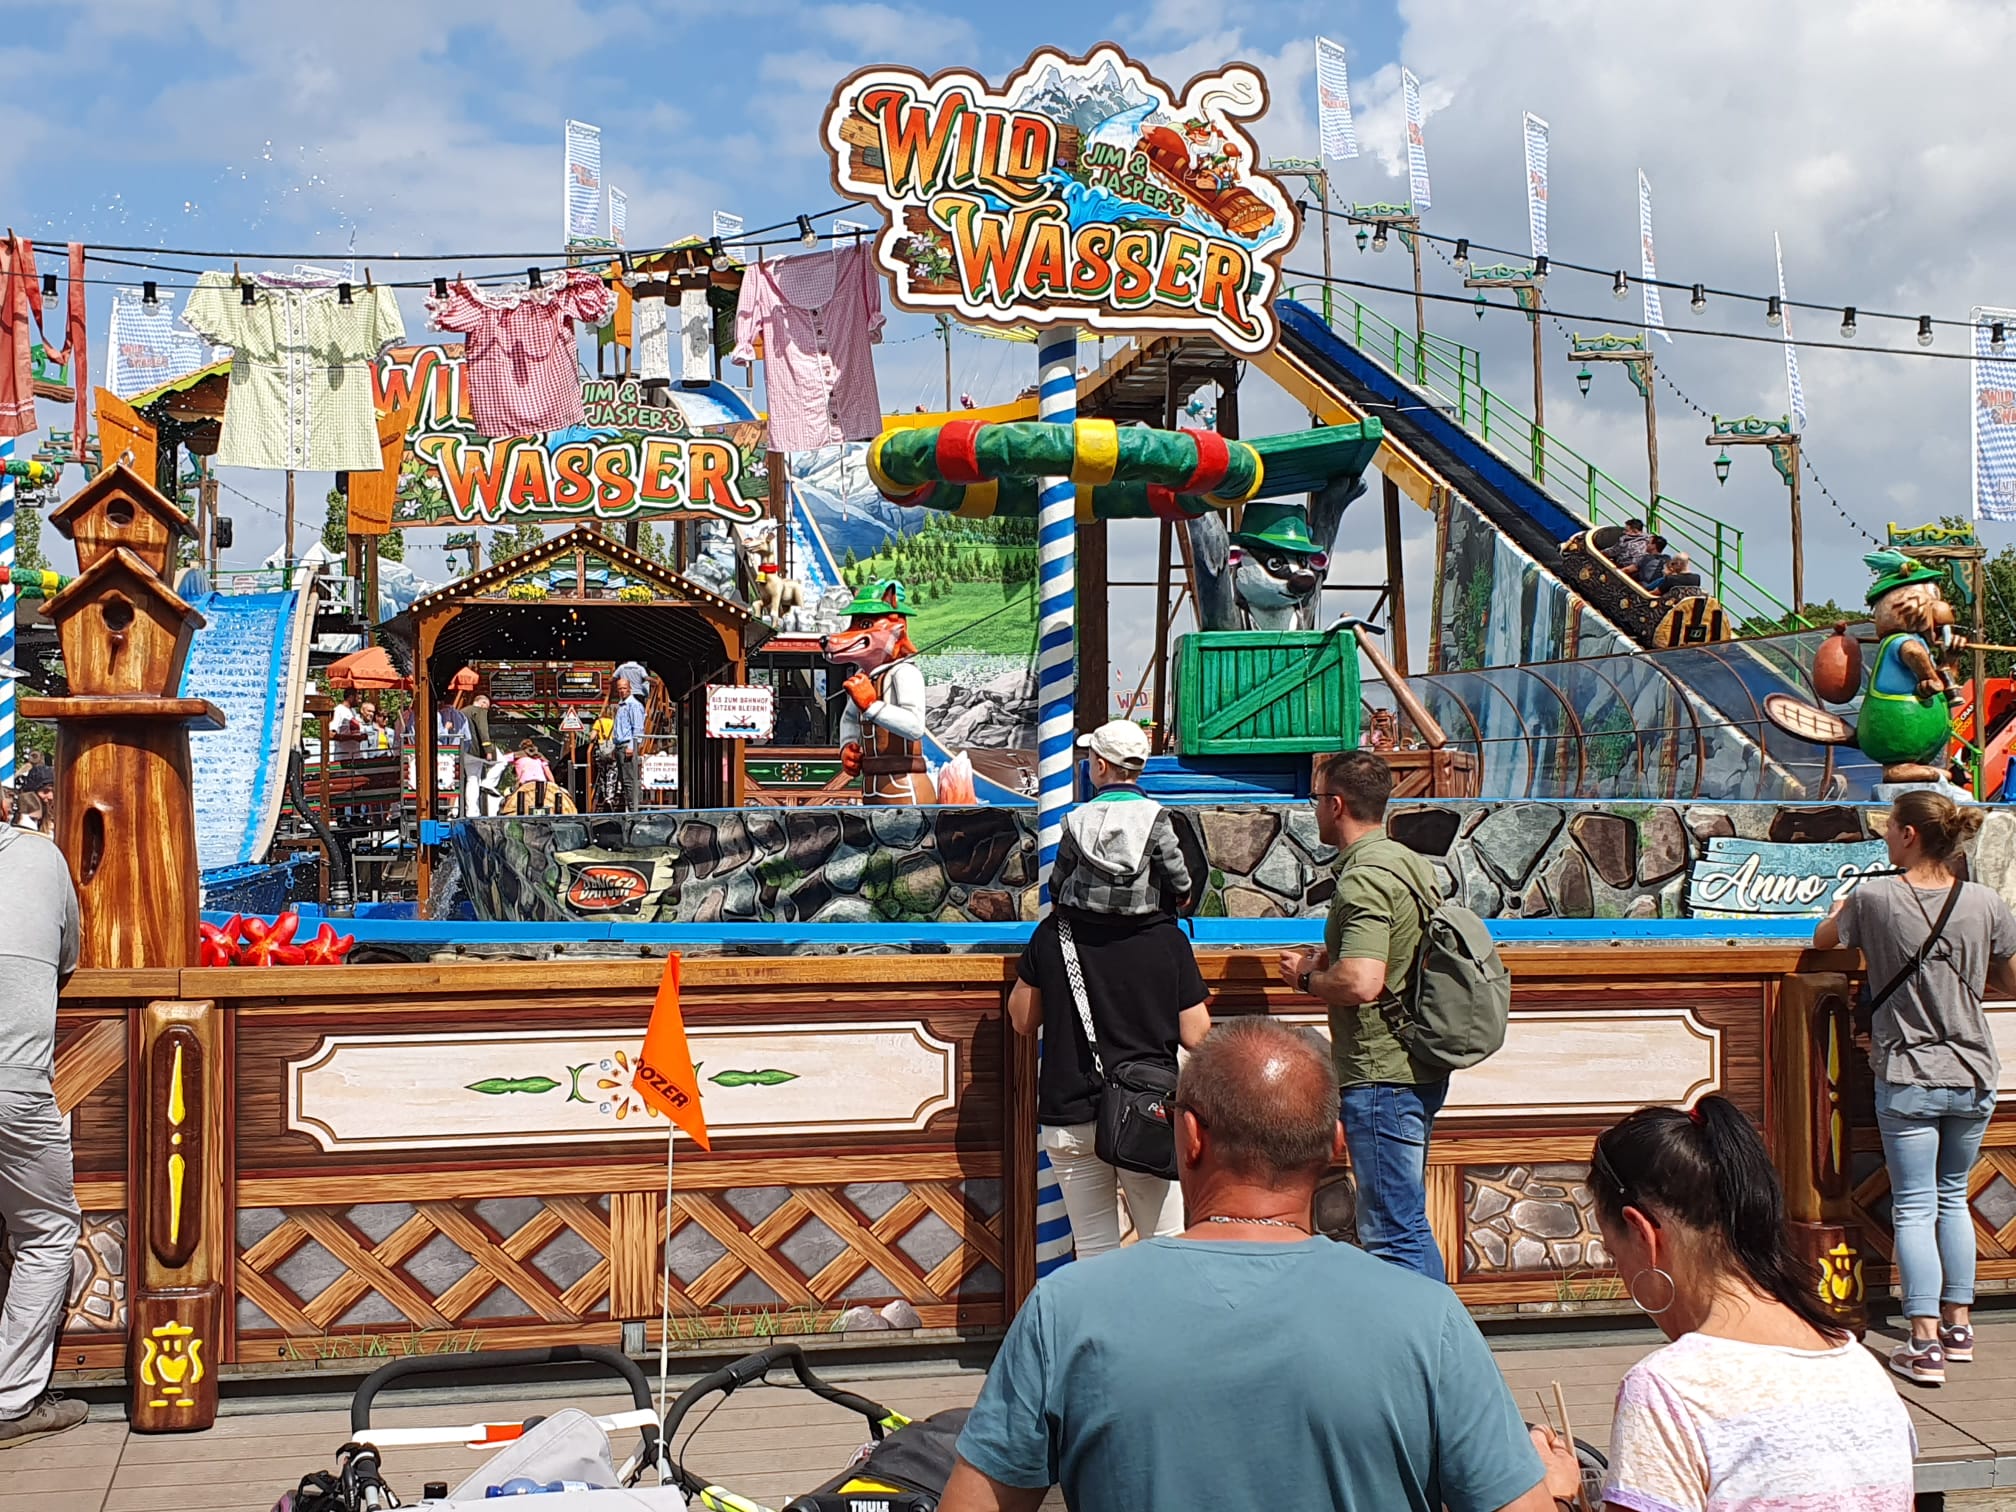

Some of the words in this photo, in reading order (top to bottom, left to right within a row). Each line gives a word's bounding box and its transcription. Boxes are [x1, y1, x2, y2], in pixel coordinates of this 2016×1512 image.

[860, 88, 1055, 201] WILD
[1086, 143, 1125, 169] JIM
[1130, 155, 1146, 177] &
[1094, 168, 1184, 214] JASPER'S
[932, 196, 1260, 338] WASSER
[583, 384, 613, 404] JIM
[621, 384, 636, 403] &
[589, 404, 680, 429] JASPER'S
[419, 434, 752, 516] WASSER
[1699, 852, 1829, 912] Anno
[849, 1500, 890, 1512] THULE
